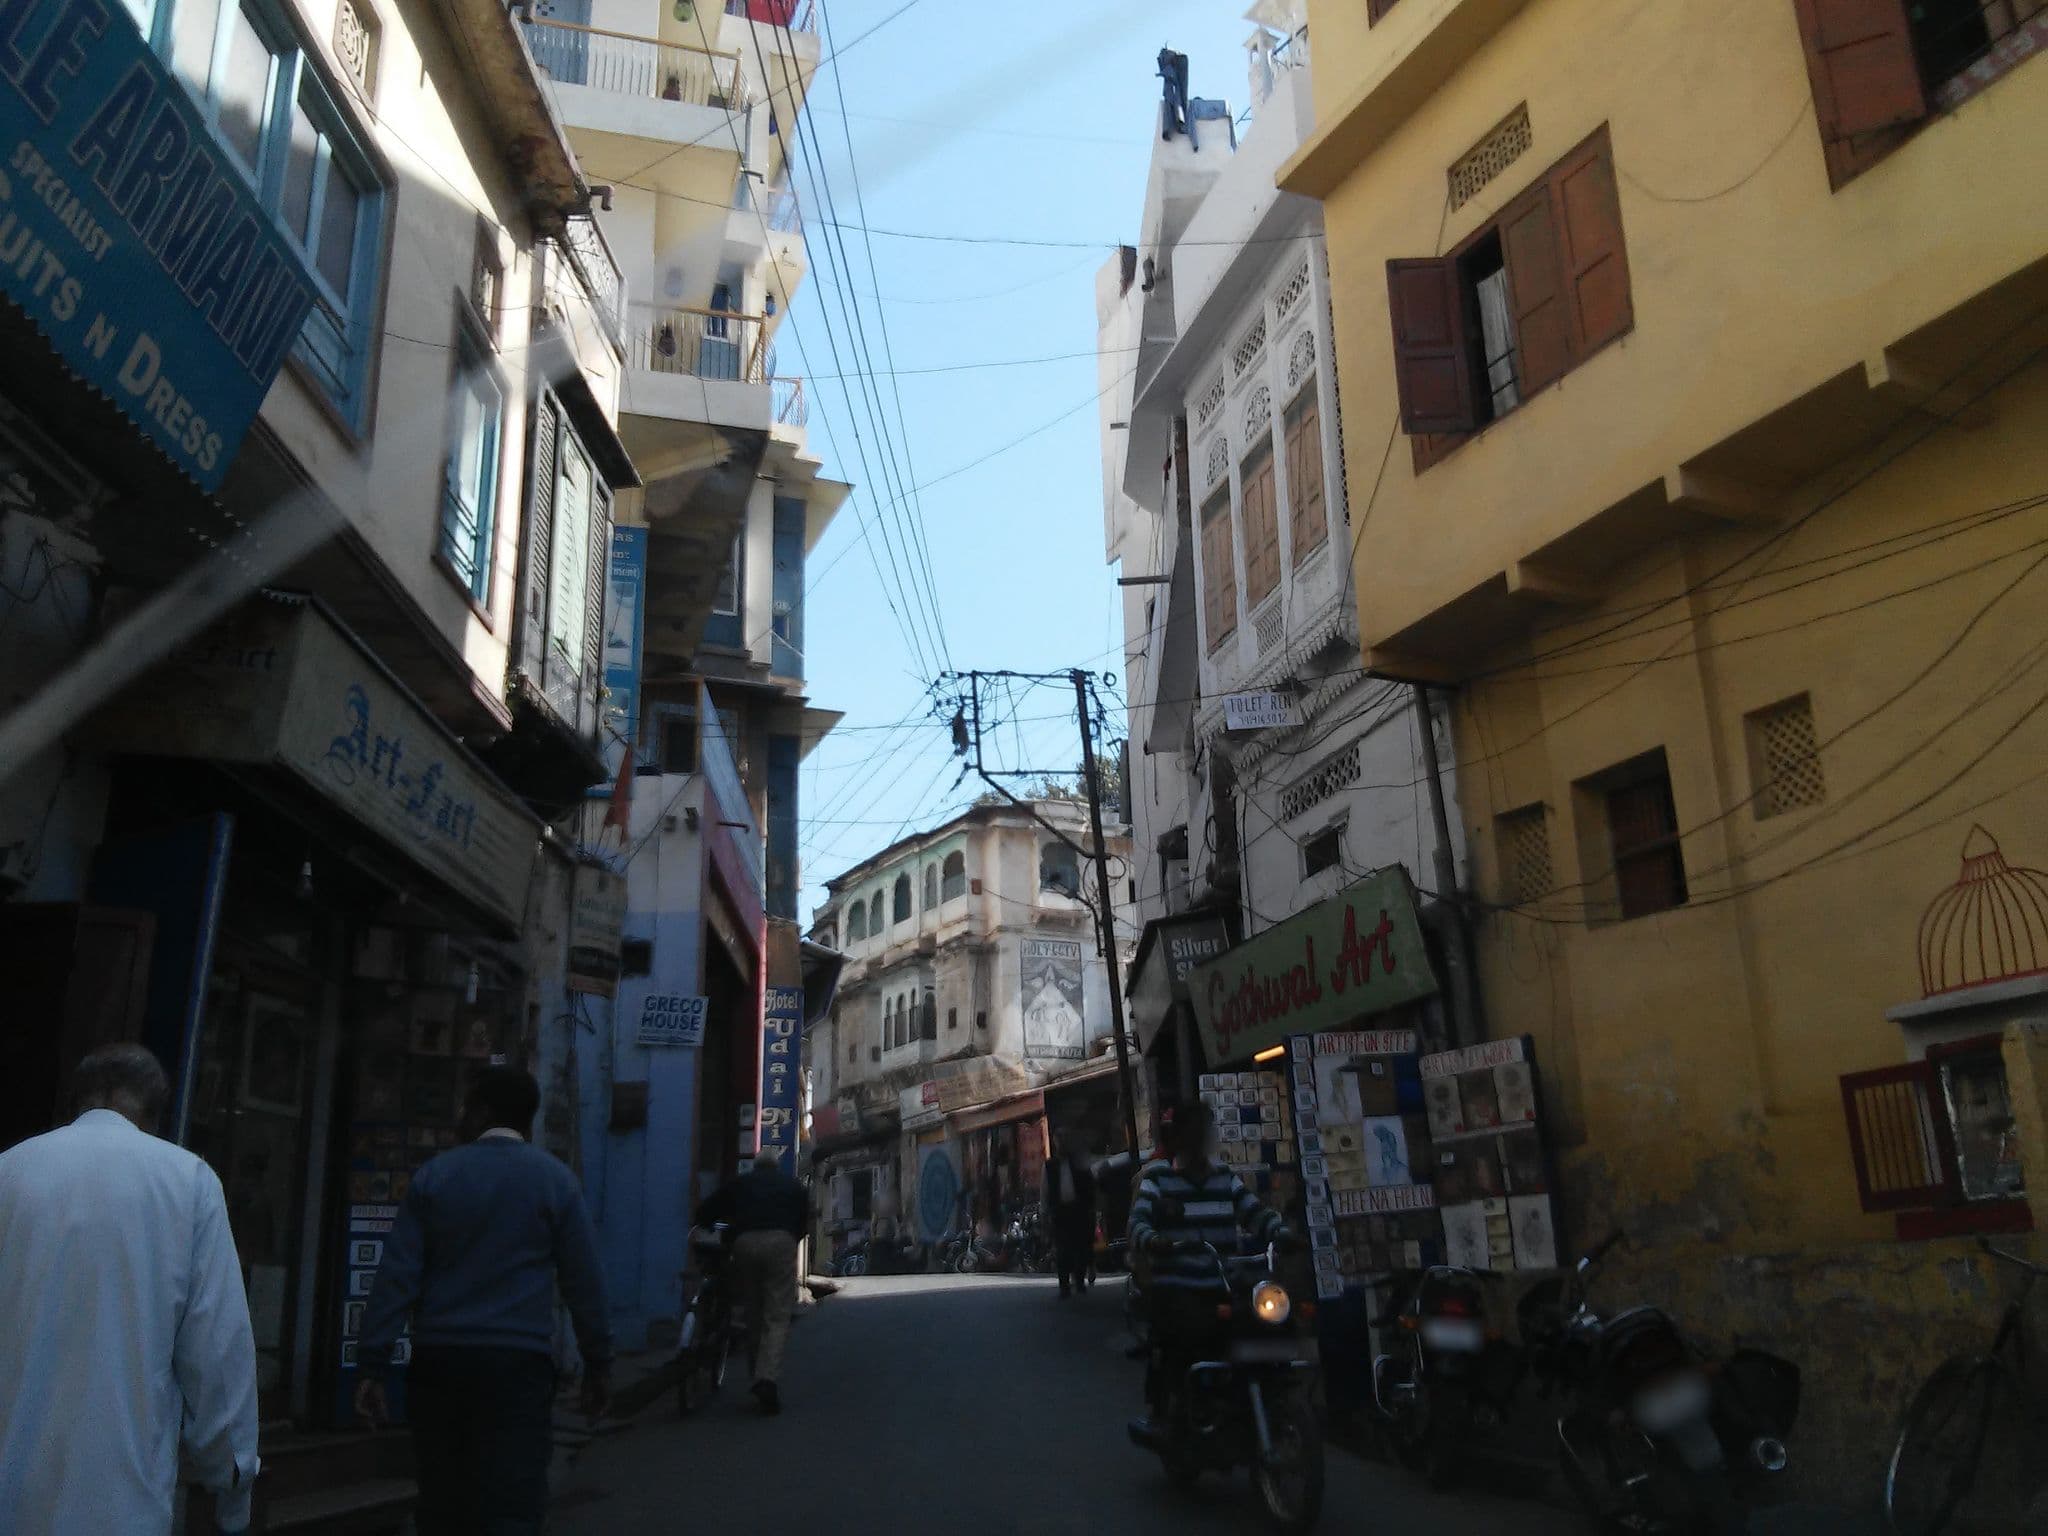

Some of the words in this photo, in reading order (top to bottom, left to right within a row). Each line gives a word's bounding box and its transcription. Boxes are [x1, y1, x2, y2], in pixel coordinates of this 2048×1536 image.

[10, 139, 114, 263] SPECIALIST
[0, 168, 83, 321] UITS
[117, 332, 224, 473] DRESS
[1171, 937, 1219, 959] Silver
[1330, 904, 1396, 995] Art
[645, 994, 704, 1014] GRECO
[764, 988, 798, 1013] Hotel
[641, 1012, 701, 1031] HOUSE
